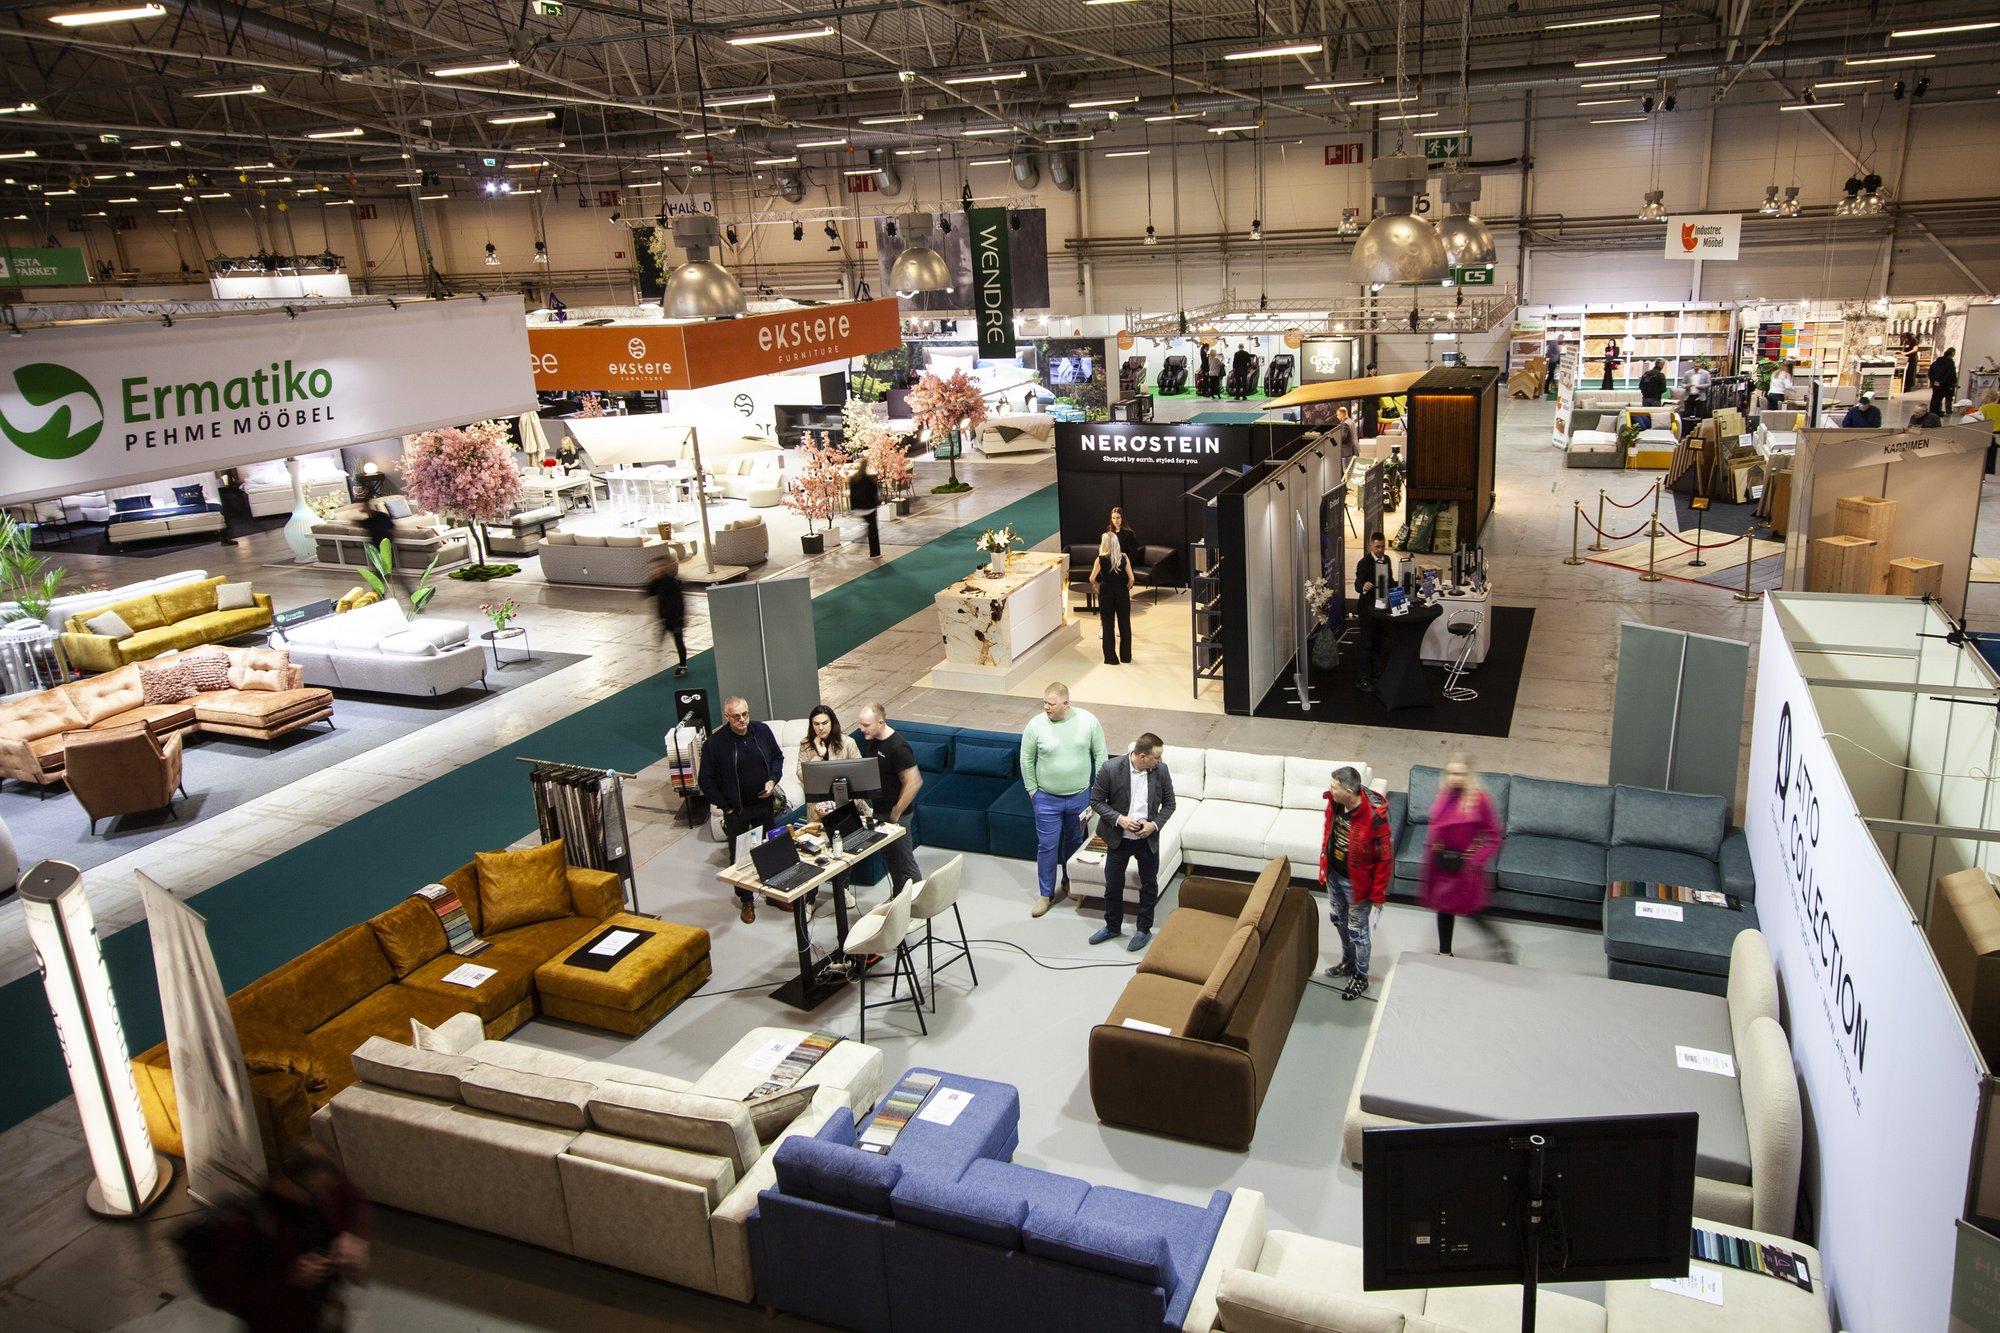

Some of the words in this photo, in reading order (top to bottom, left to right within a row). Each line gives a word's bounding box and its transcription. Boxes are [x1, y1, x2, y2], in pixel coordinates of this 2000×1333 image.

[703, 201, 712, 212] D
[980, 225, 1005, 344] WENDRE
[1464, 271, 1486, 282] C5
[758, 315, 850, 352] ekstere
[608, 362, 672, 375] ekstere
[778, 345, 841, 364] FURNITURE
[121, 359, 333, 424] Ermatiko
[124, 421, 222, 451] PEHME
[233, 405, 335, 435] MÖÖBEL
[1102, 455, 1127, 463] Shaped
[1795, 753, 1820, 848] ATTO
[1790, 814, 1868, 1074] COLLECTION
